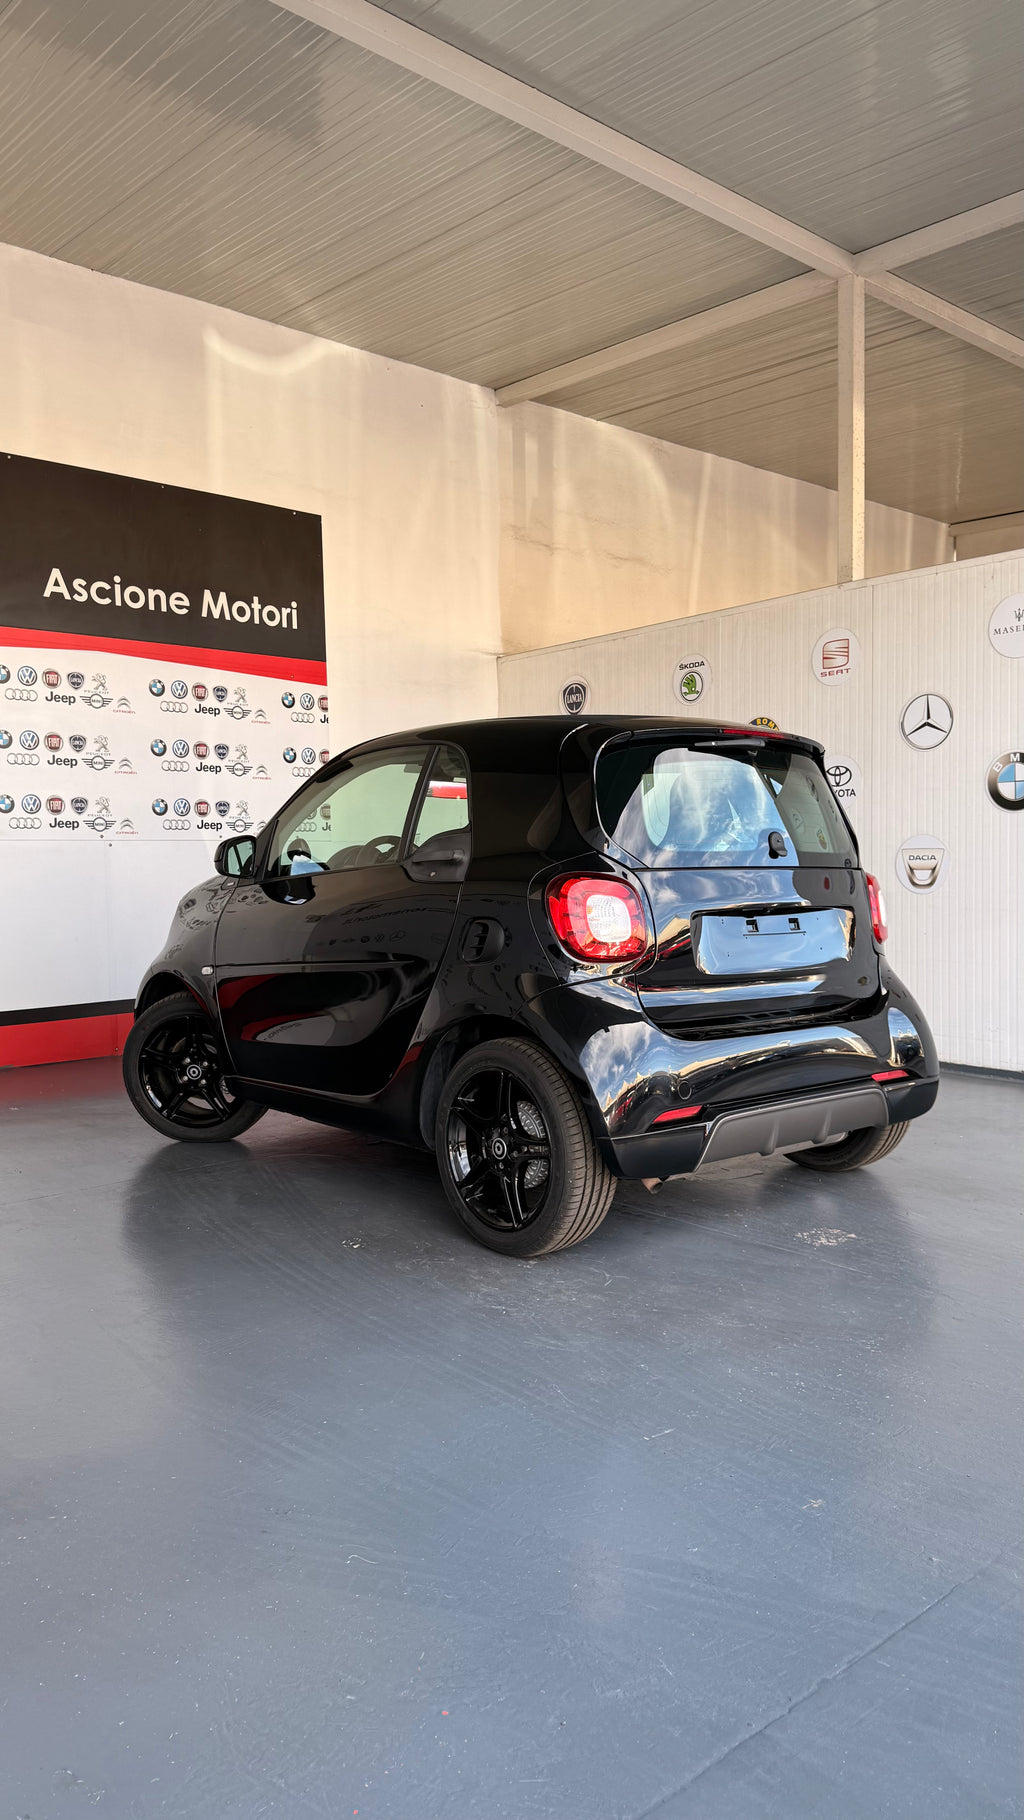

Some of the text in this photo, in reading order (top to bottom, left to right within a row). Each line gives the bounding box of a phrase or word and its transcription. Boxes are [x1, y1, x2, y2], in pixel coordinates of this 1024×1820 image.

[43, 568, 298, 630] Ascione Motori
[994, 625, 1024, 635] MASE
[820, 668, 851, 677] SEAT
[45, 691, 76, 705] Jeep
[195, 704, 220, 716] Jeep
[47, 755, 78, 768] Jeep
[993, 753, 1021, 773] BM
[196, 762, 221, 774] Jeep
[49, 818, 79, 830] Jeep
[197, 820, 222, 831] Jeep
